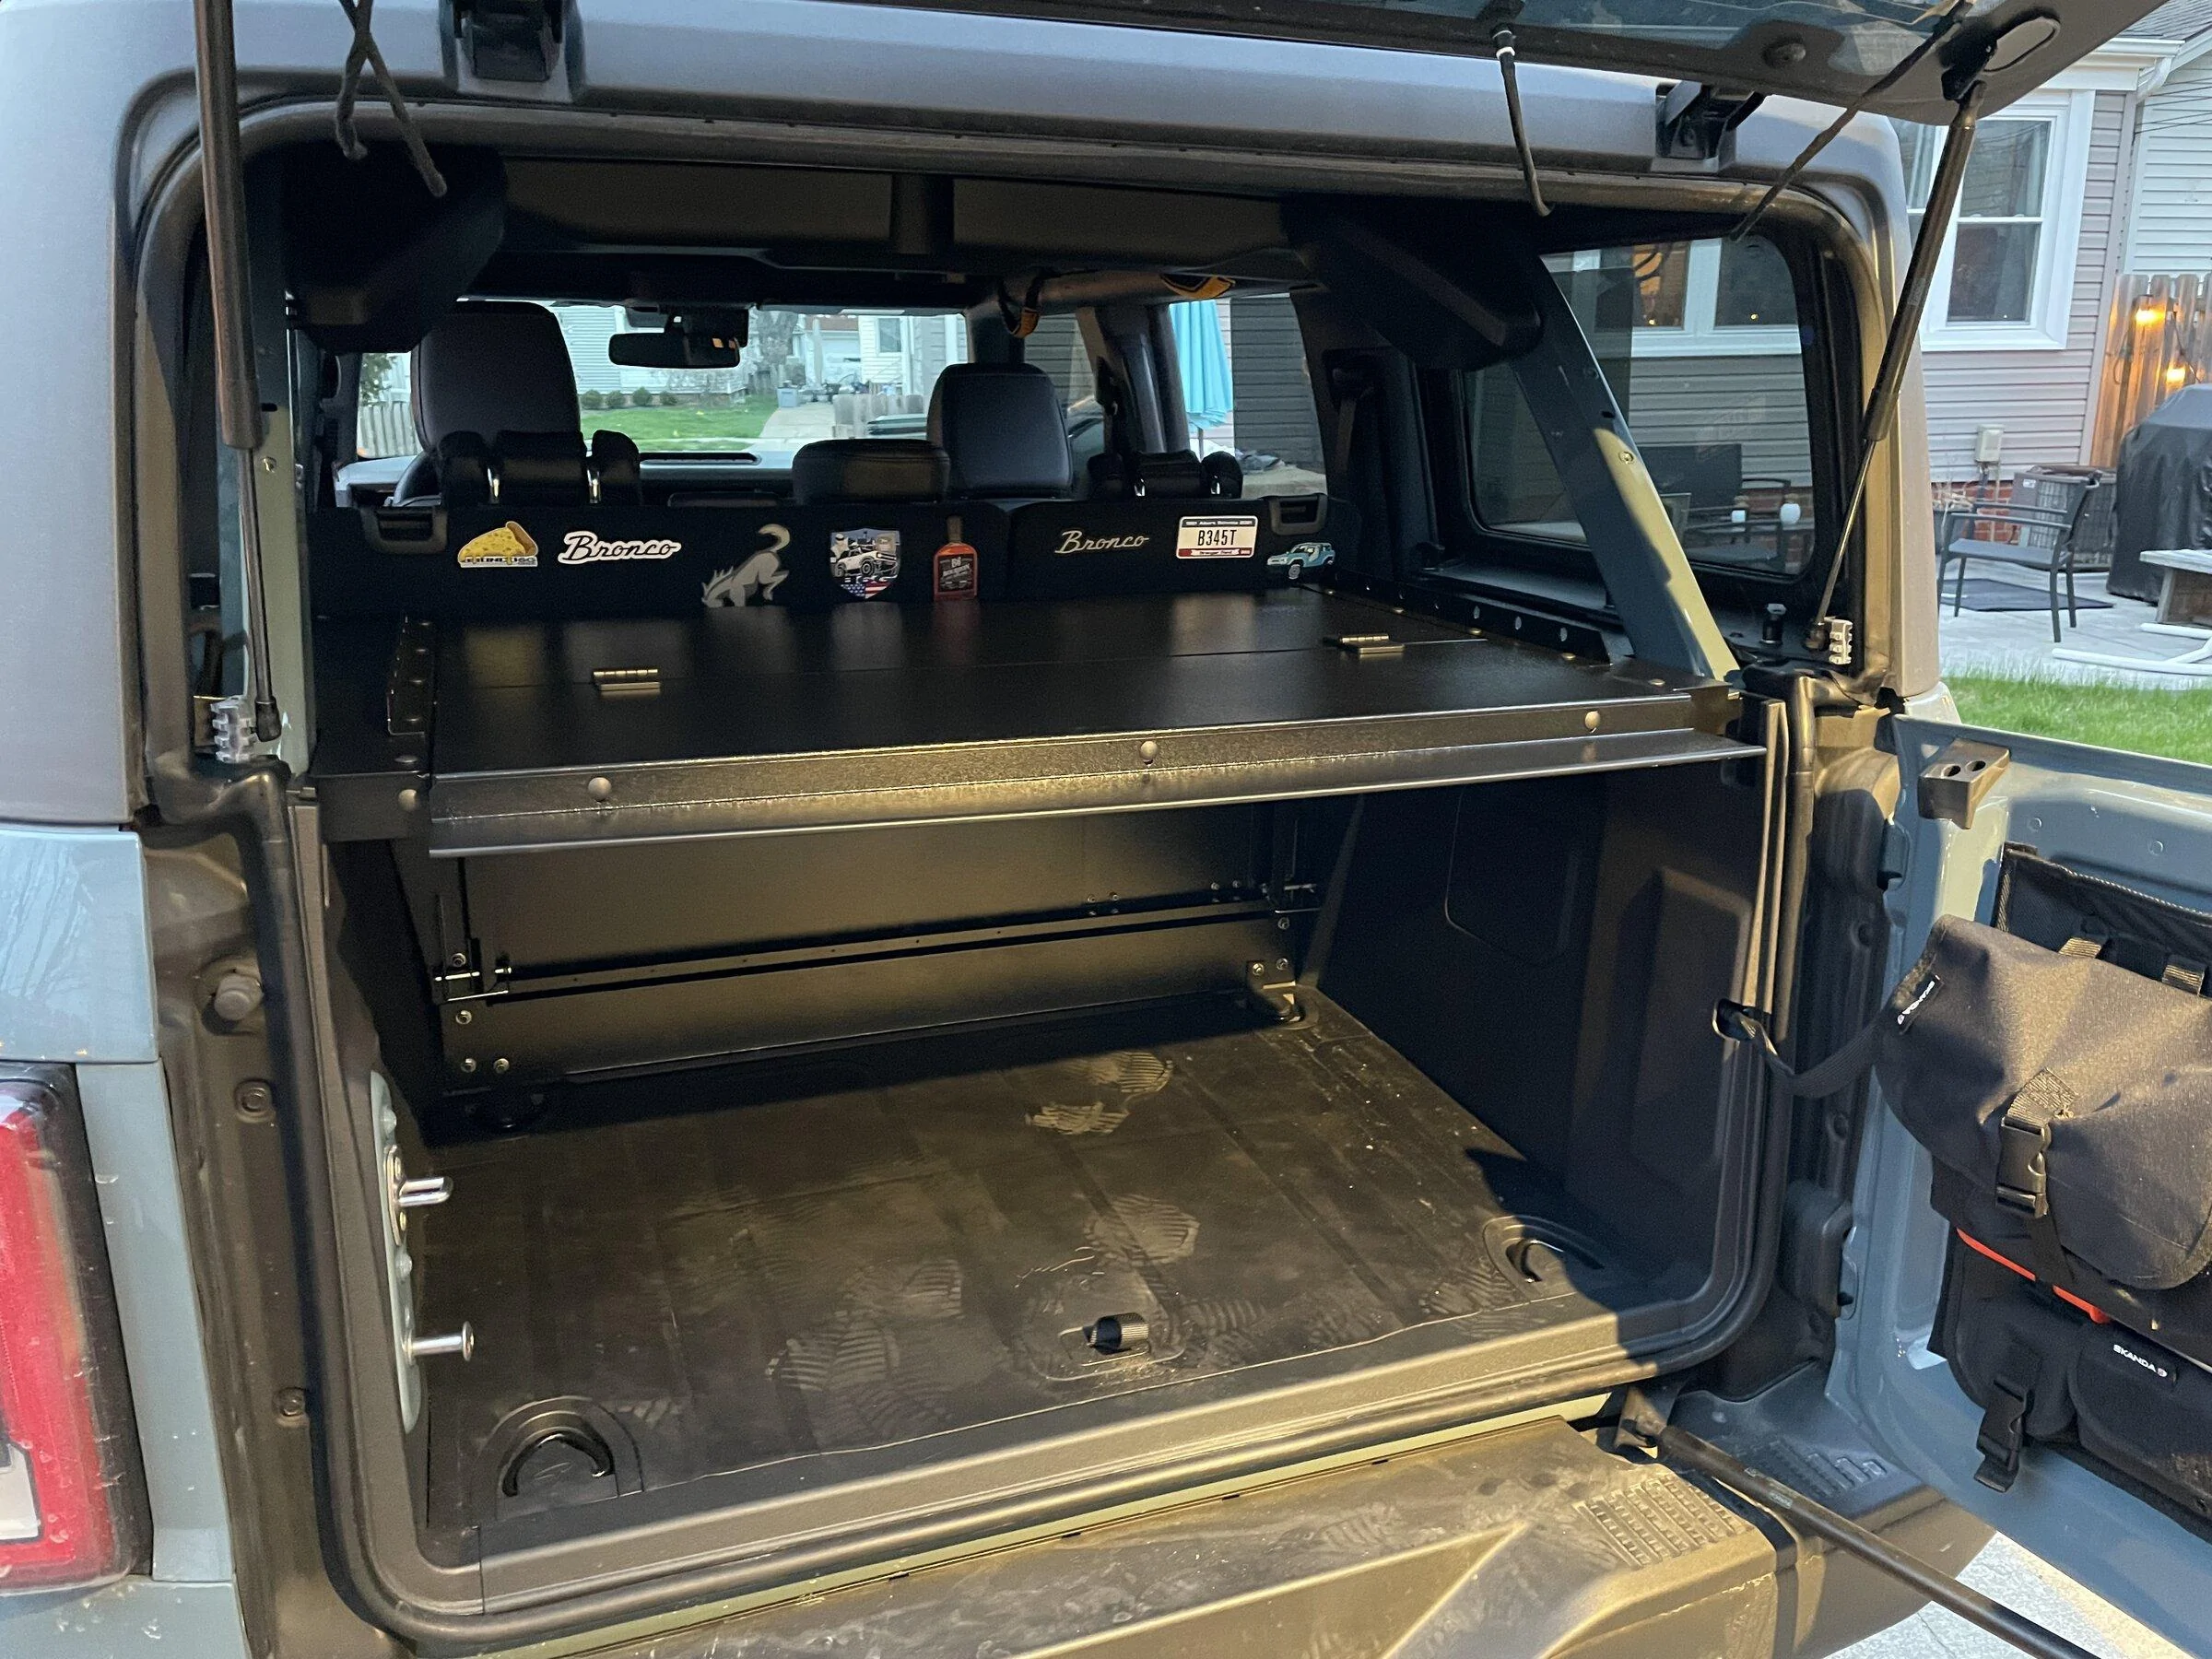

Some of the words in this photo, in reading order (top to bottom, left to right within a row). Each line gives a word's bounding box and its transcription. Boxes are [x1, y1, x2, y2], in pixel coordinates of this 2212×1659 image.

[562, 535, 679, 561] Bronco
[1055, 530, 1150, 554] Bronco
[1197, 529, 1238, 547] B345T
[2112, 1344, 2157, 1373] SKANDA
